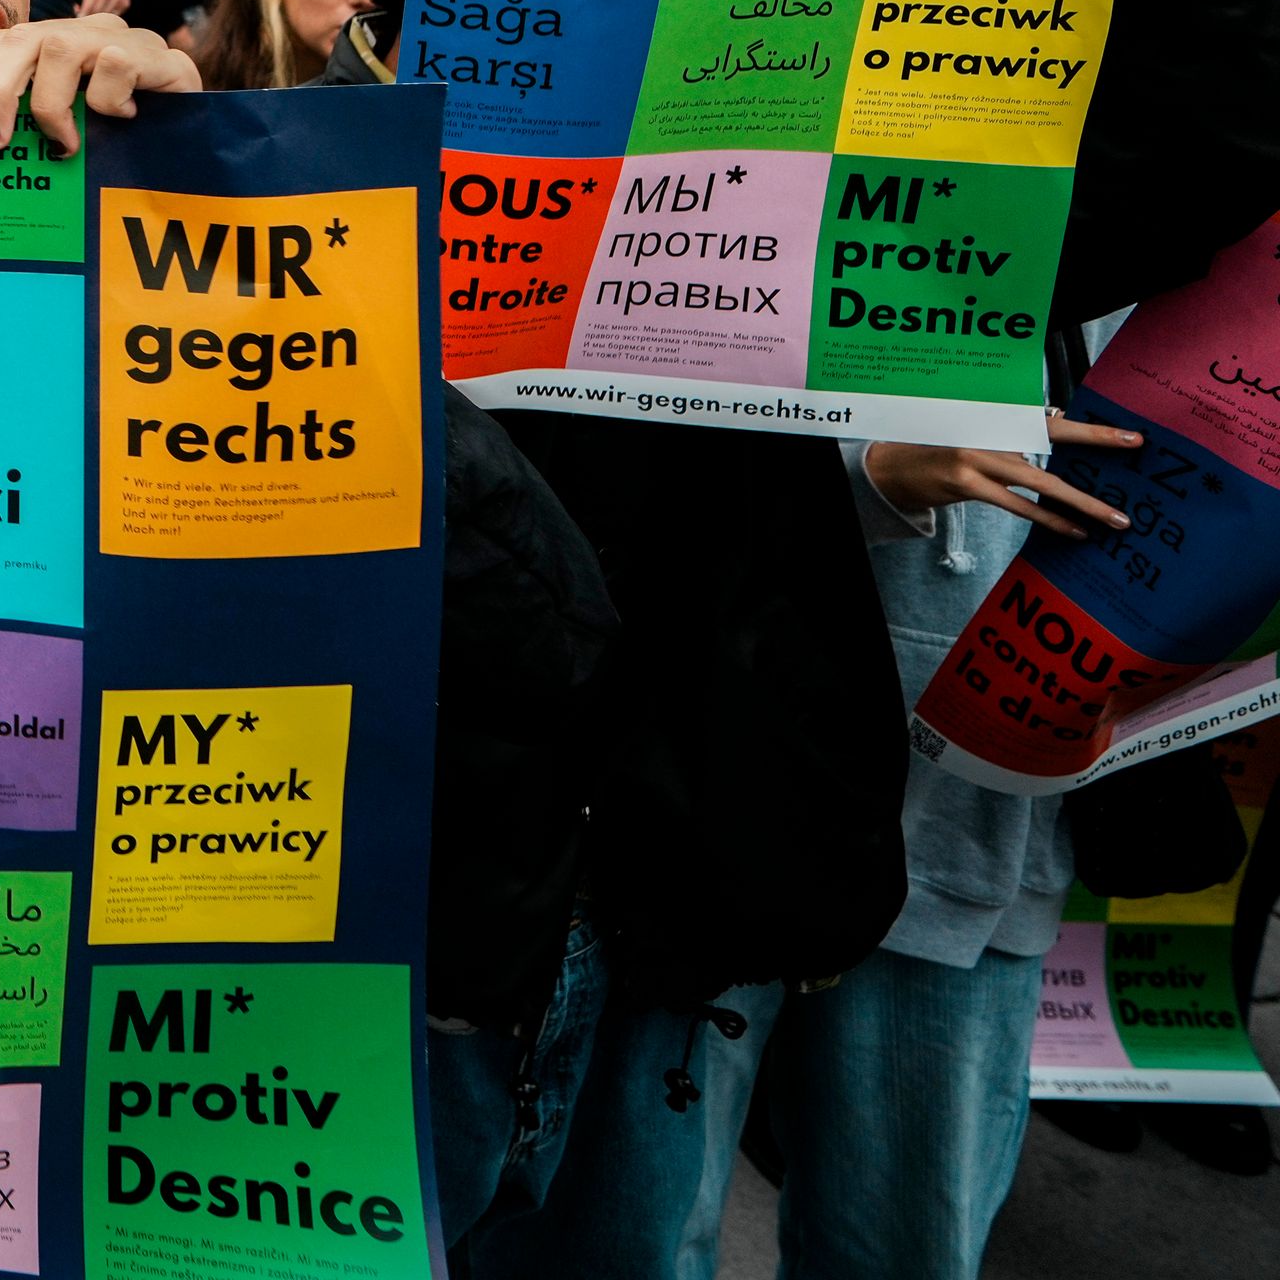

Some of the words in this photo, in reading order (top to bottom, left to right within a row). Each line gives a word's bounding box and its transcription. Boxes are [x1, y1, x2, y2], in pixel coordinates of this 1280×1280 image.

[864, 50, 889, 69] o
[901, 47, 1087, 89] prawicy
[832, 239, 1011, 278] protiv
[829, 288, 1035, 339] Desnice
[125, 325, 356, 391] gegen
[515, 379, 853, 424] www.wir-gegen-rechts.at
[128, 402, 355, 463] rechts
[122, 492, 140, 502] Wir
[146, 495, 169, 505] sind
[174, 499, 210, 509] gegen
[215, 495, 317, 507] Rechtsextremismus
[320, 494, 339, 504] und
[342, 489, 400, 501] Rechtsruck.
[134, 478, 153, 489] Wir
[157, 479, 181, 491] sind
[186, 482, 215, 492] viele.
[220, 483, 237, 492] Wir
[241, 482, 263, 492] sind
[267, 482, 301, 491] divers.
[123, 508, 146, 519] Und
[151, 510, 168, 520] wir
[172, 513, 190, 521] tun
[194, 514, 227, 522] etwas
[231, 511, 284, 523] dagegen!
[123, 523, 155, 535] Mach
[159, 526, 181, 535] mit!
[115, 768, 311, 815] przeciwk
[112, 835, 136, 854] o
[151, 820, 327, 863] prawicy
[108, 1066, 339, 1132] protiv
[108, 1145, 403, 1241] Desnice
